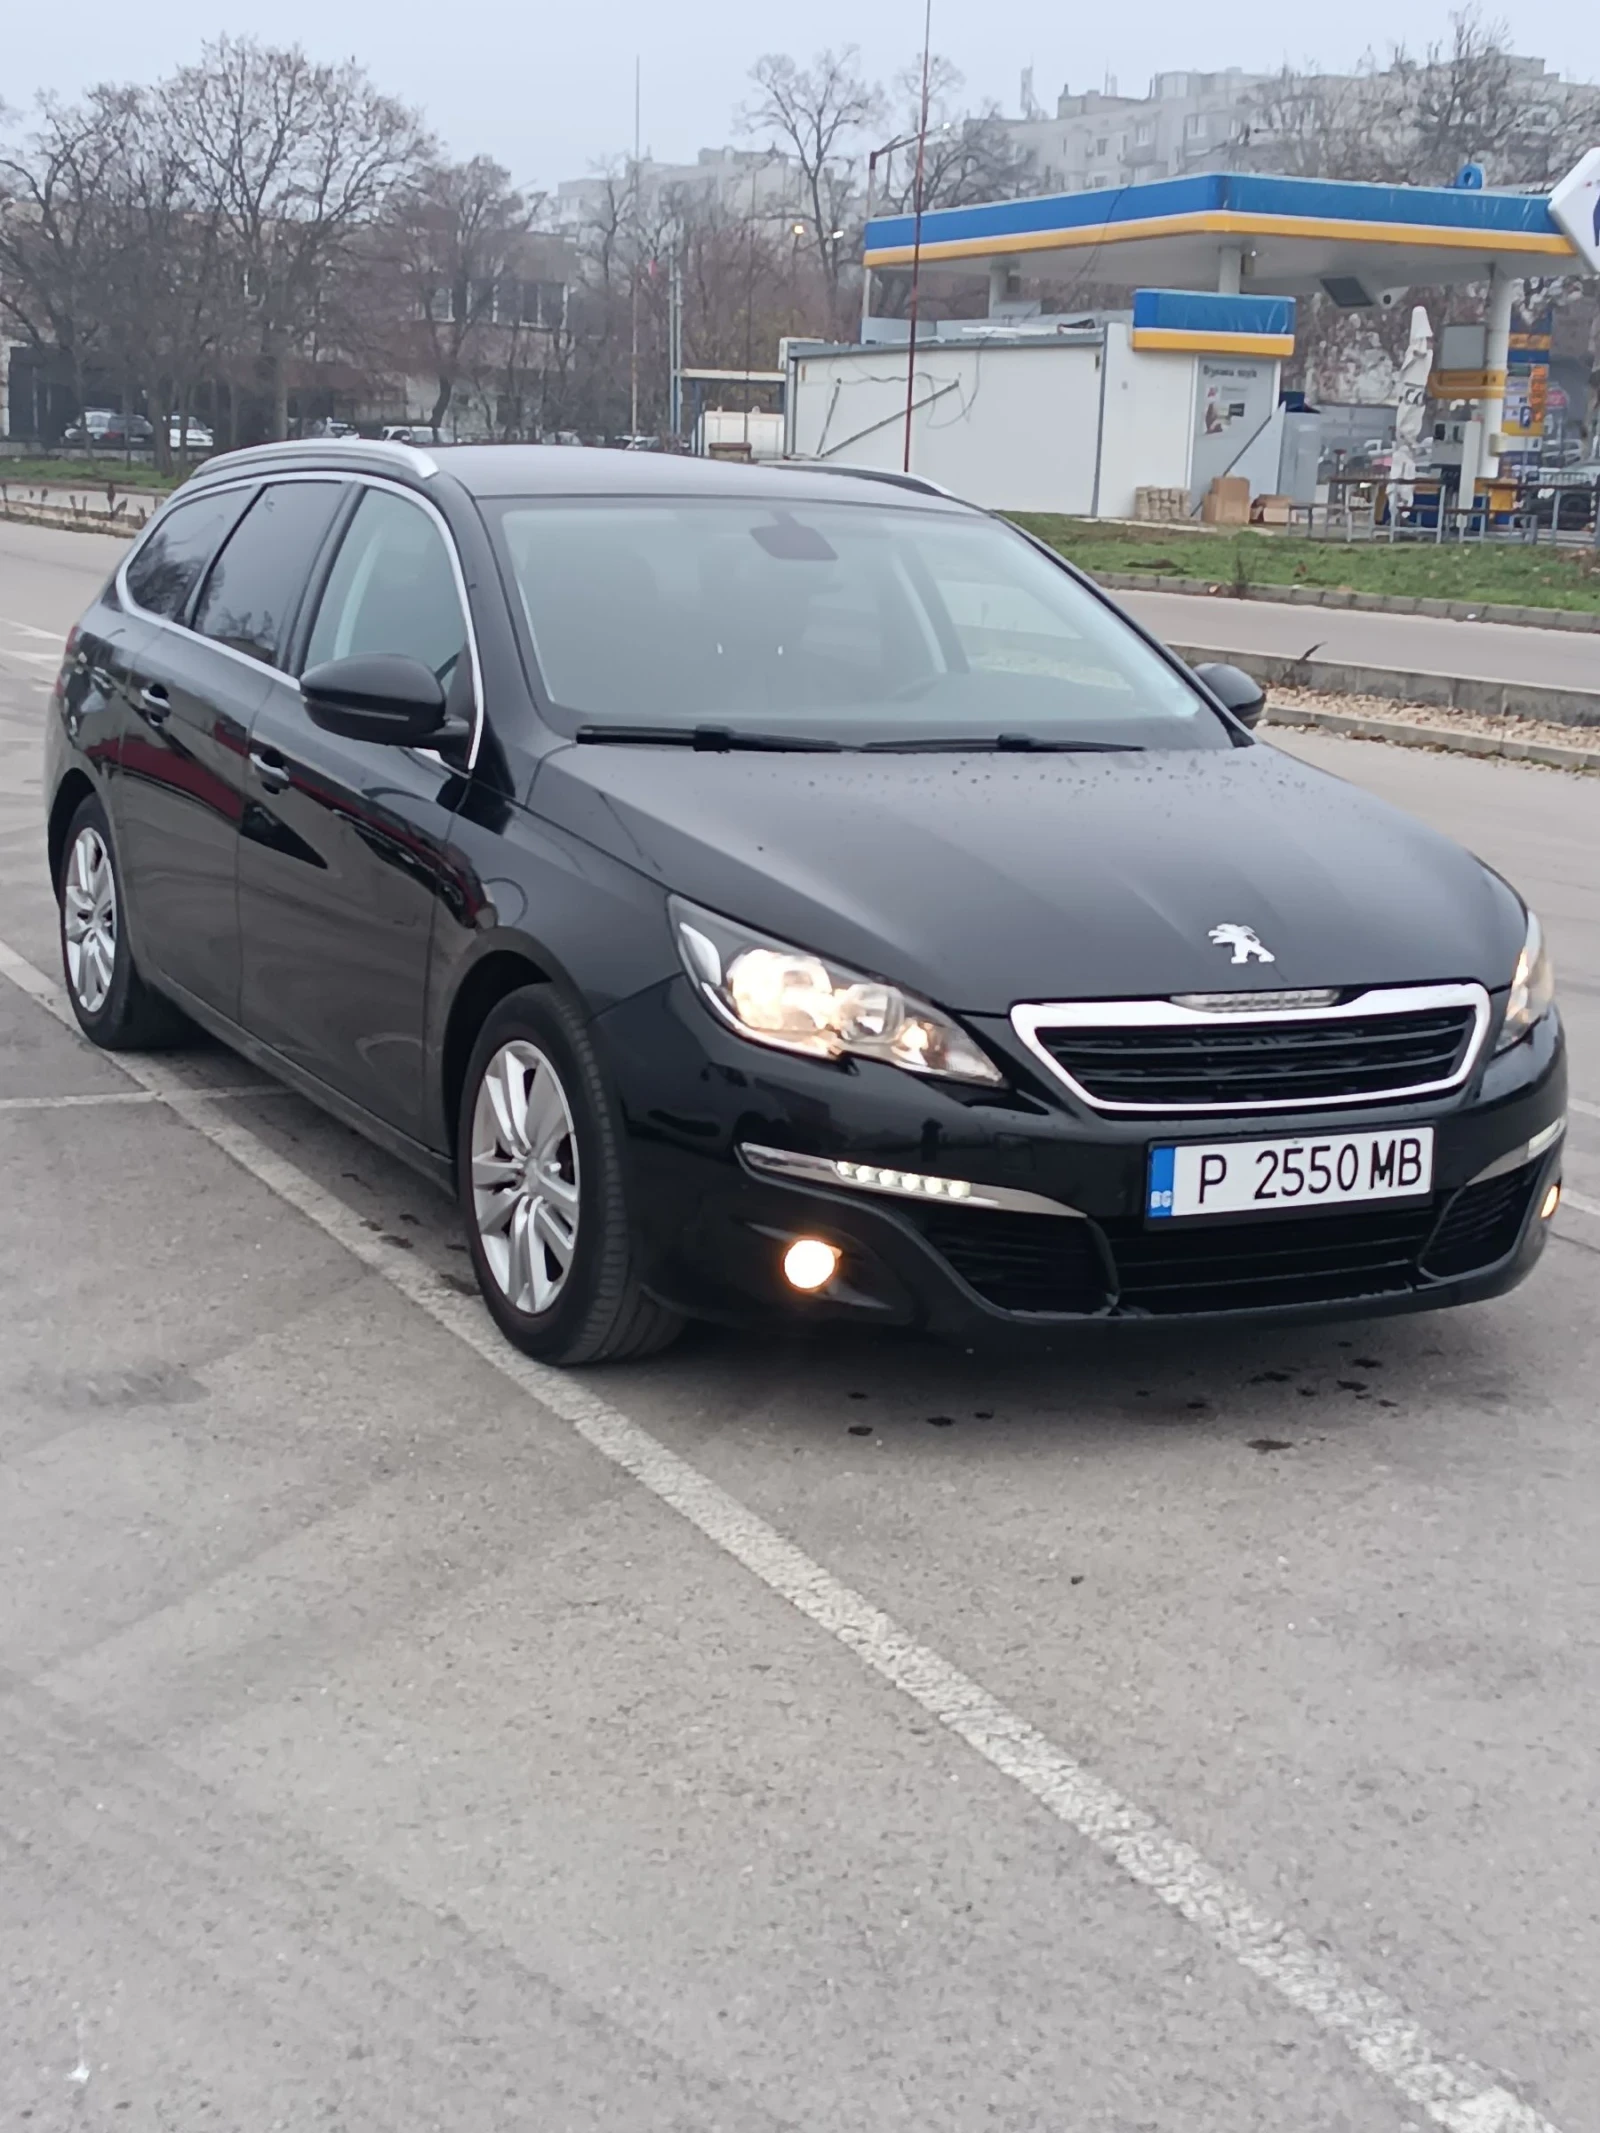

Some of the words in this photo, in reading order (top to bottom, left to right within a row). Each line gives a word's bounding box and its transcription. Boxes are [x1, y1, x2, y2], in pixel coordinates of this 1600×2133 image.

[1198, 1154, 1227, 1204] P
[1254, 1143, 1359, 1200] 2550
[1369, 1137, 1422, 1190] MB
